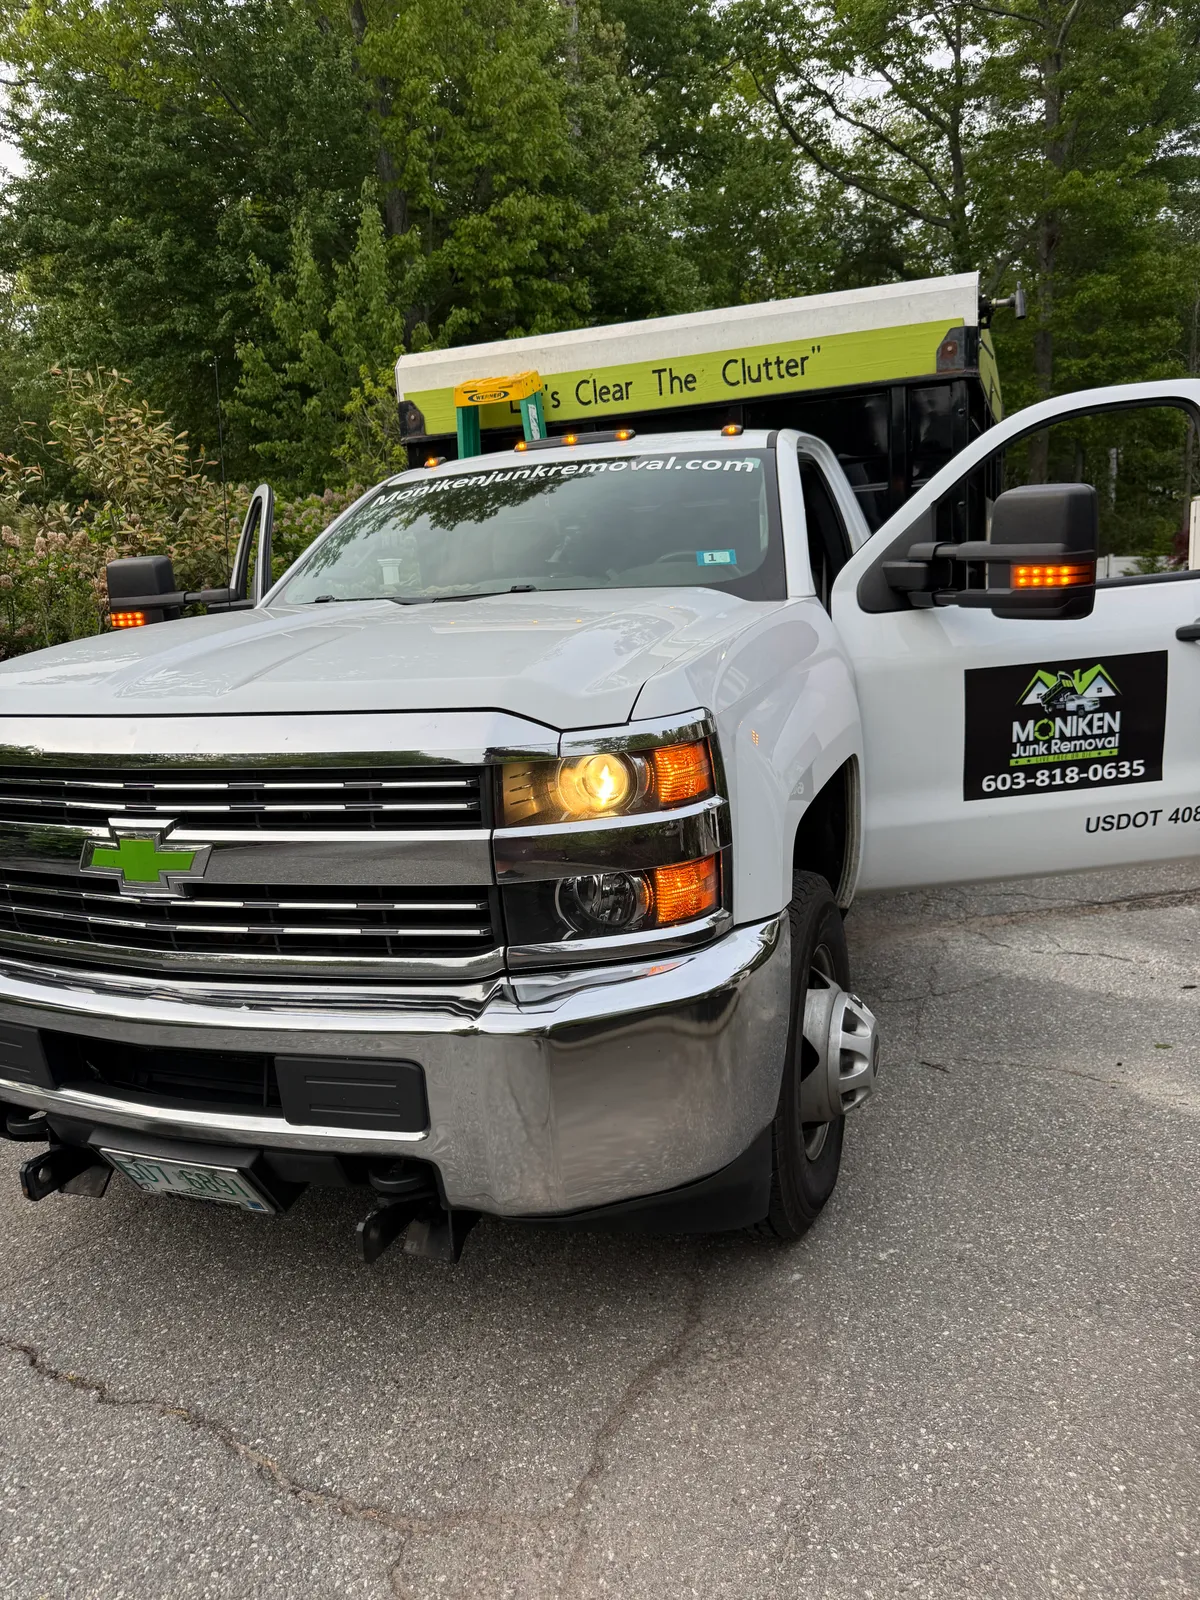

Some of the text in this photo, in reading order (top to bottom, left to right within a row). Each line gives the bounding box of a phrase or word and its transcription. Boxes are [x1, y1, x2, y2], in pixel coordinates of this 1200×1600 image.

[575, 378, 634, 406] Clear
[652, 367, 697, 396] The
[722, 345, 821, 387] Clutter"
[475, 392, 502, 401] WERNER
[371, 456, 755, 508] Monikenjunkremoval.com
[708, 553, 717, 562] 1
[1012, 710, 1121, 743] MONIKEN
[1011, 733, 1120, 758] Junk Removal
[981, 759, 1146, 792] 603-818-0635
[1085, 805, 1200, 833] USDOT 408
